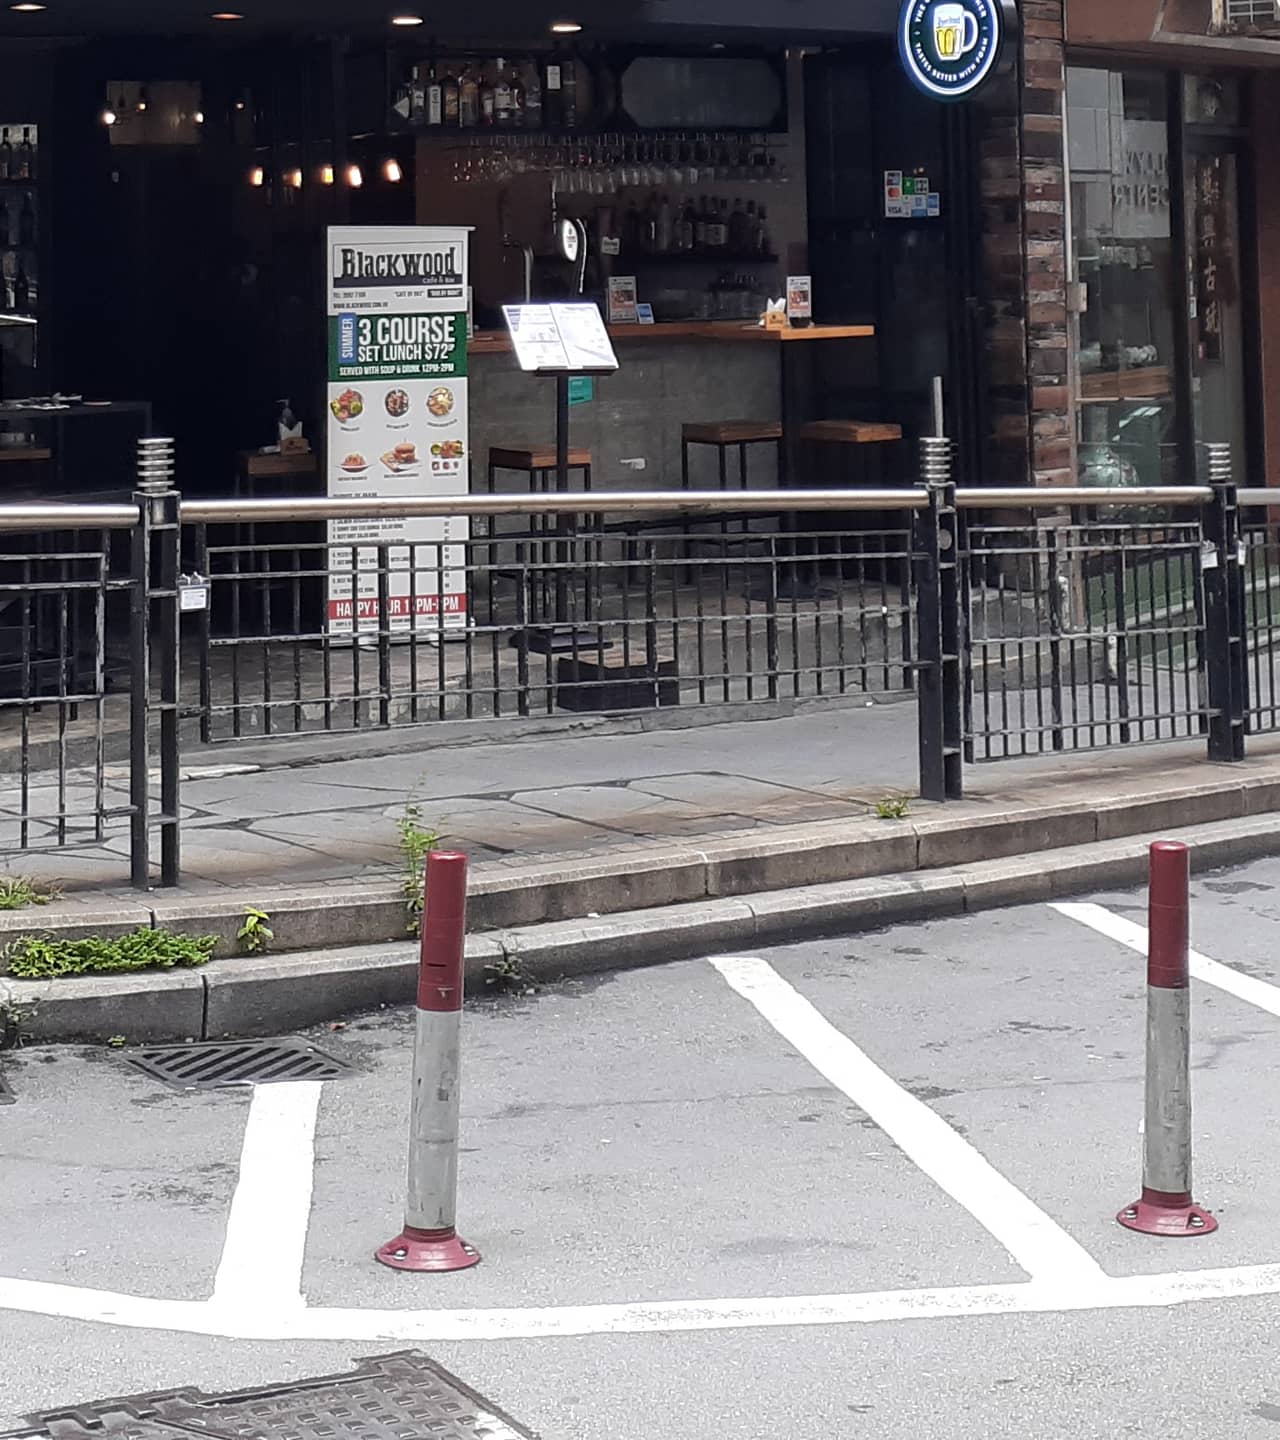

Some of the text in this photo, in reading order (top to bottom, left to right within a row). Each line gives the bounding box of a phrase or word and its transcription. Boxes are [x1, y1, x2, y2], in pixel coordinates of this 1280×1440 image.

[340, 246, 457, 279] Blackwood
[341, 318, 354, 359] SUMMER
[358, 315, 456, 345] 3 COURSE
[358, 345, 380, 363] SET
[382, 343, 422, 361] LUNCH
